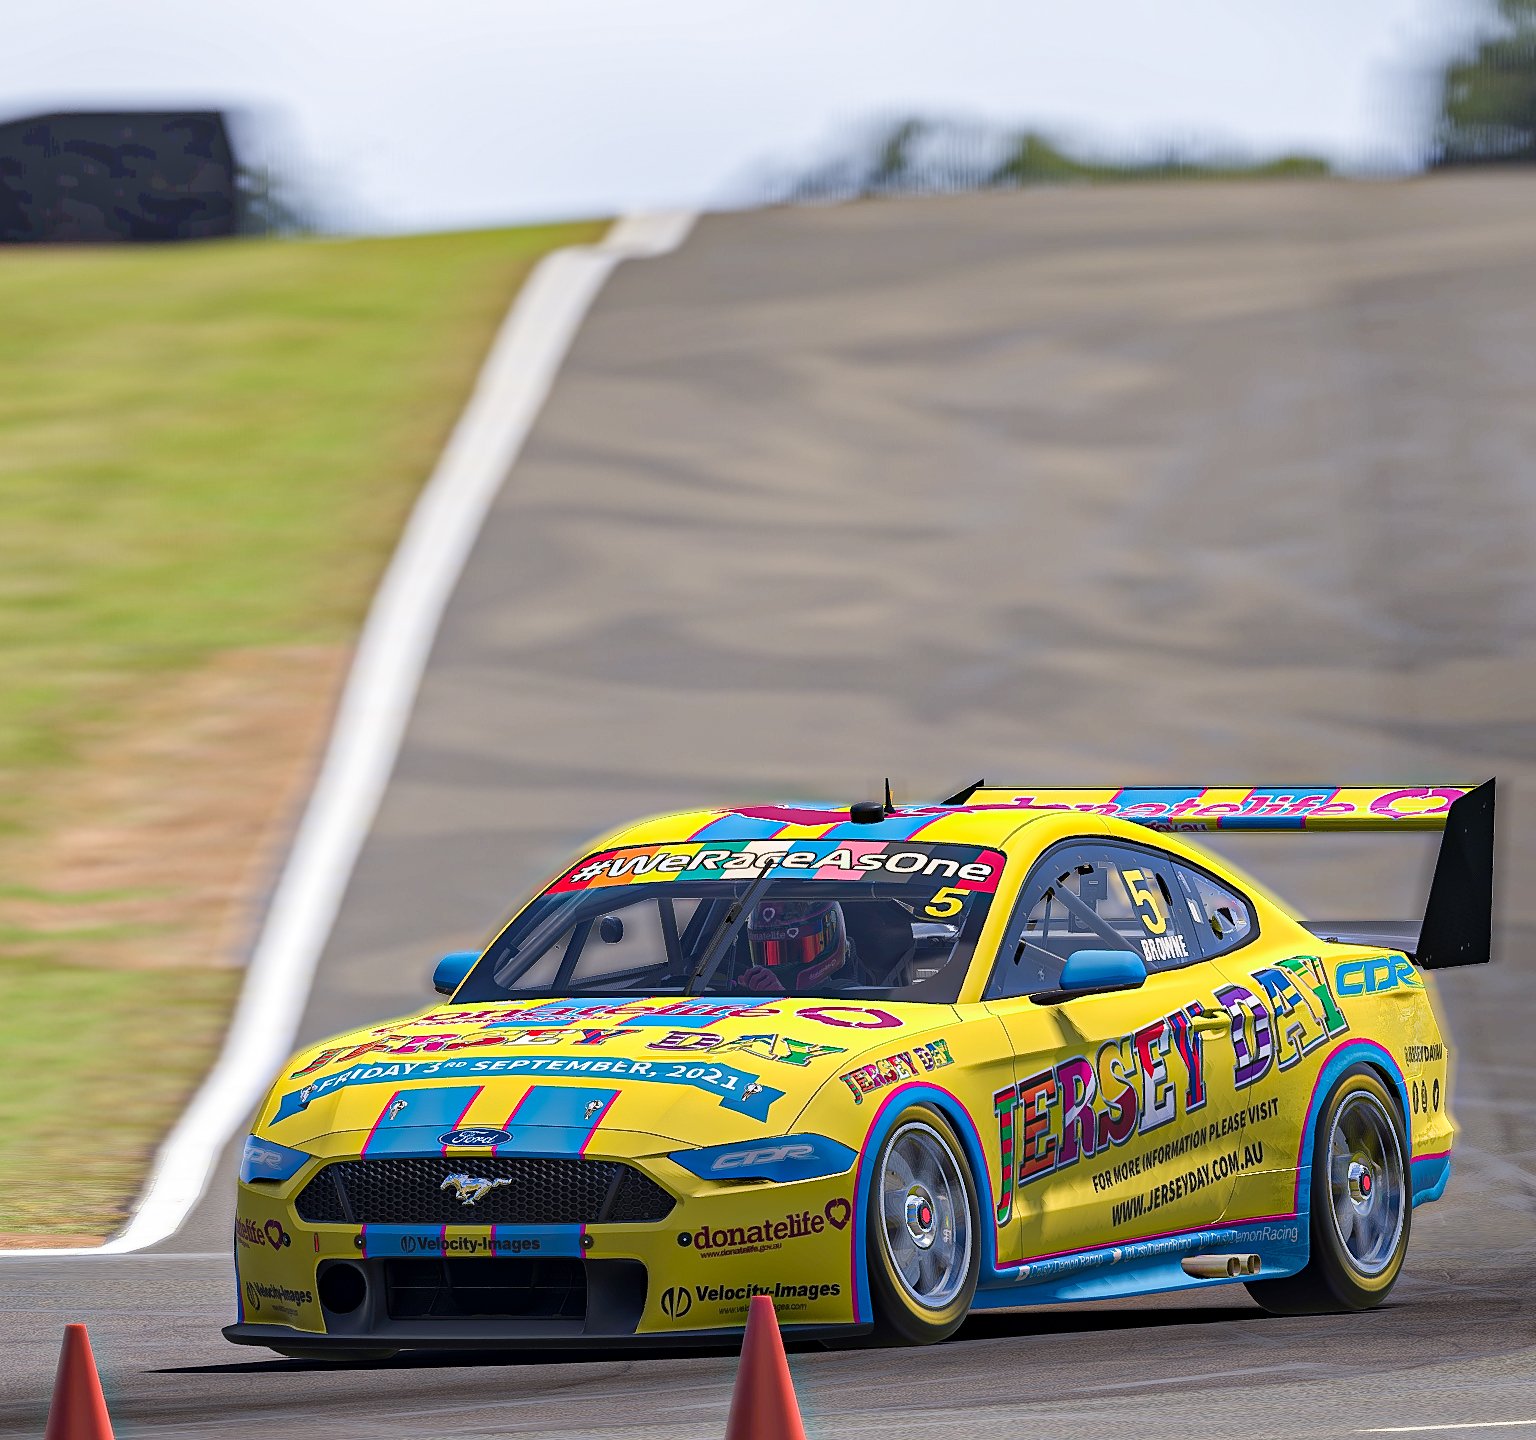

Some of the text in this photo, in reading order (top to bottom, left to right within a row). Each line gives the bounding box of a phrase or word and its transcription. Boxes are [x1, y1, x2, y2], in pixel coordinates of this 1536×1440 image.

[569, 849, 993, 883] #WeRaceAsOne
[924, 887, 972, 918] 5
[1122, 869, 1167, 934] 5
[1140, 935, 1189, 962] BROWNE
[1333, 953, 1426, 998] CDR
[288, 1028, 849, 1080] JERSEY DAY
[838, 1038, 955, 1105] JERSEY DAY
[317, 1061, 417, 1093] FRIDAY
[470, 1060, 656, 1076] SEPTEMBER,
[665, 1067, 739, 1091] 2021
[992, 955, 1349, 1226] JERSEY DAY
[451, 1129, 500, 1145] Ford
[1092, 1097, 1279, 1194] FOR MORE INFORMATION PLEASE VISIT
[711, 1143, 820, 1172] CDR
[1112, 1141, 1264, 1227] WWW.JERSEYDAY.COM.AU
[417, 1236, 541, 1251] Velocity-Images
[694, 1211, 825, 1250] donatelife
[695, 1282, 841, 1302] Velocity-Images
